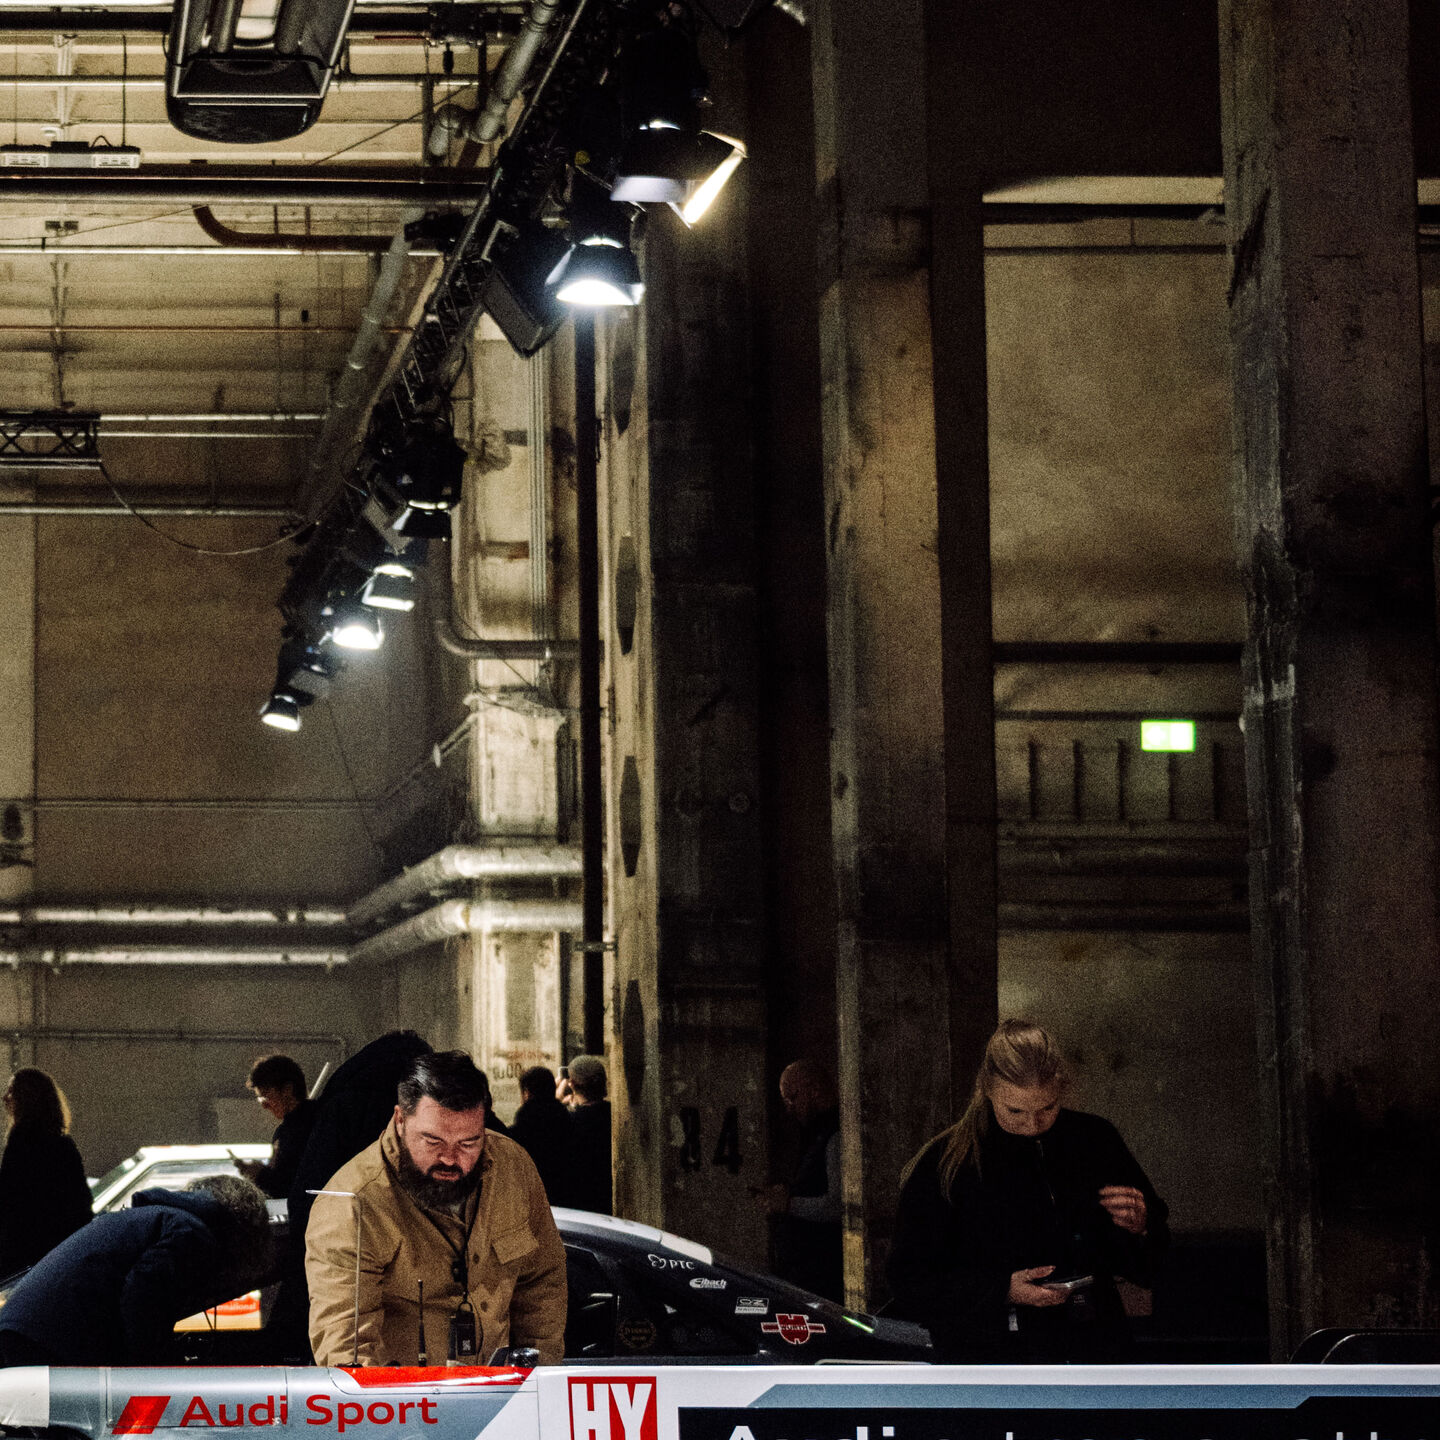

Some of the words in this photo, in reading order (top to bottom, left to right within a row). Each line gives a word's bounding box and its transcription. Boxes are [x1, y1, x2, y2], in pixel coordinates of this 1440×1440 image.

[669, 1260, 694, 1270] PTC
[180, 1395, 288, 1427] Audi
[306, 1393, 438, 1432] Sport
